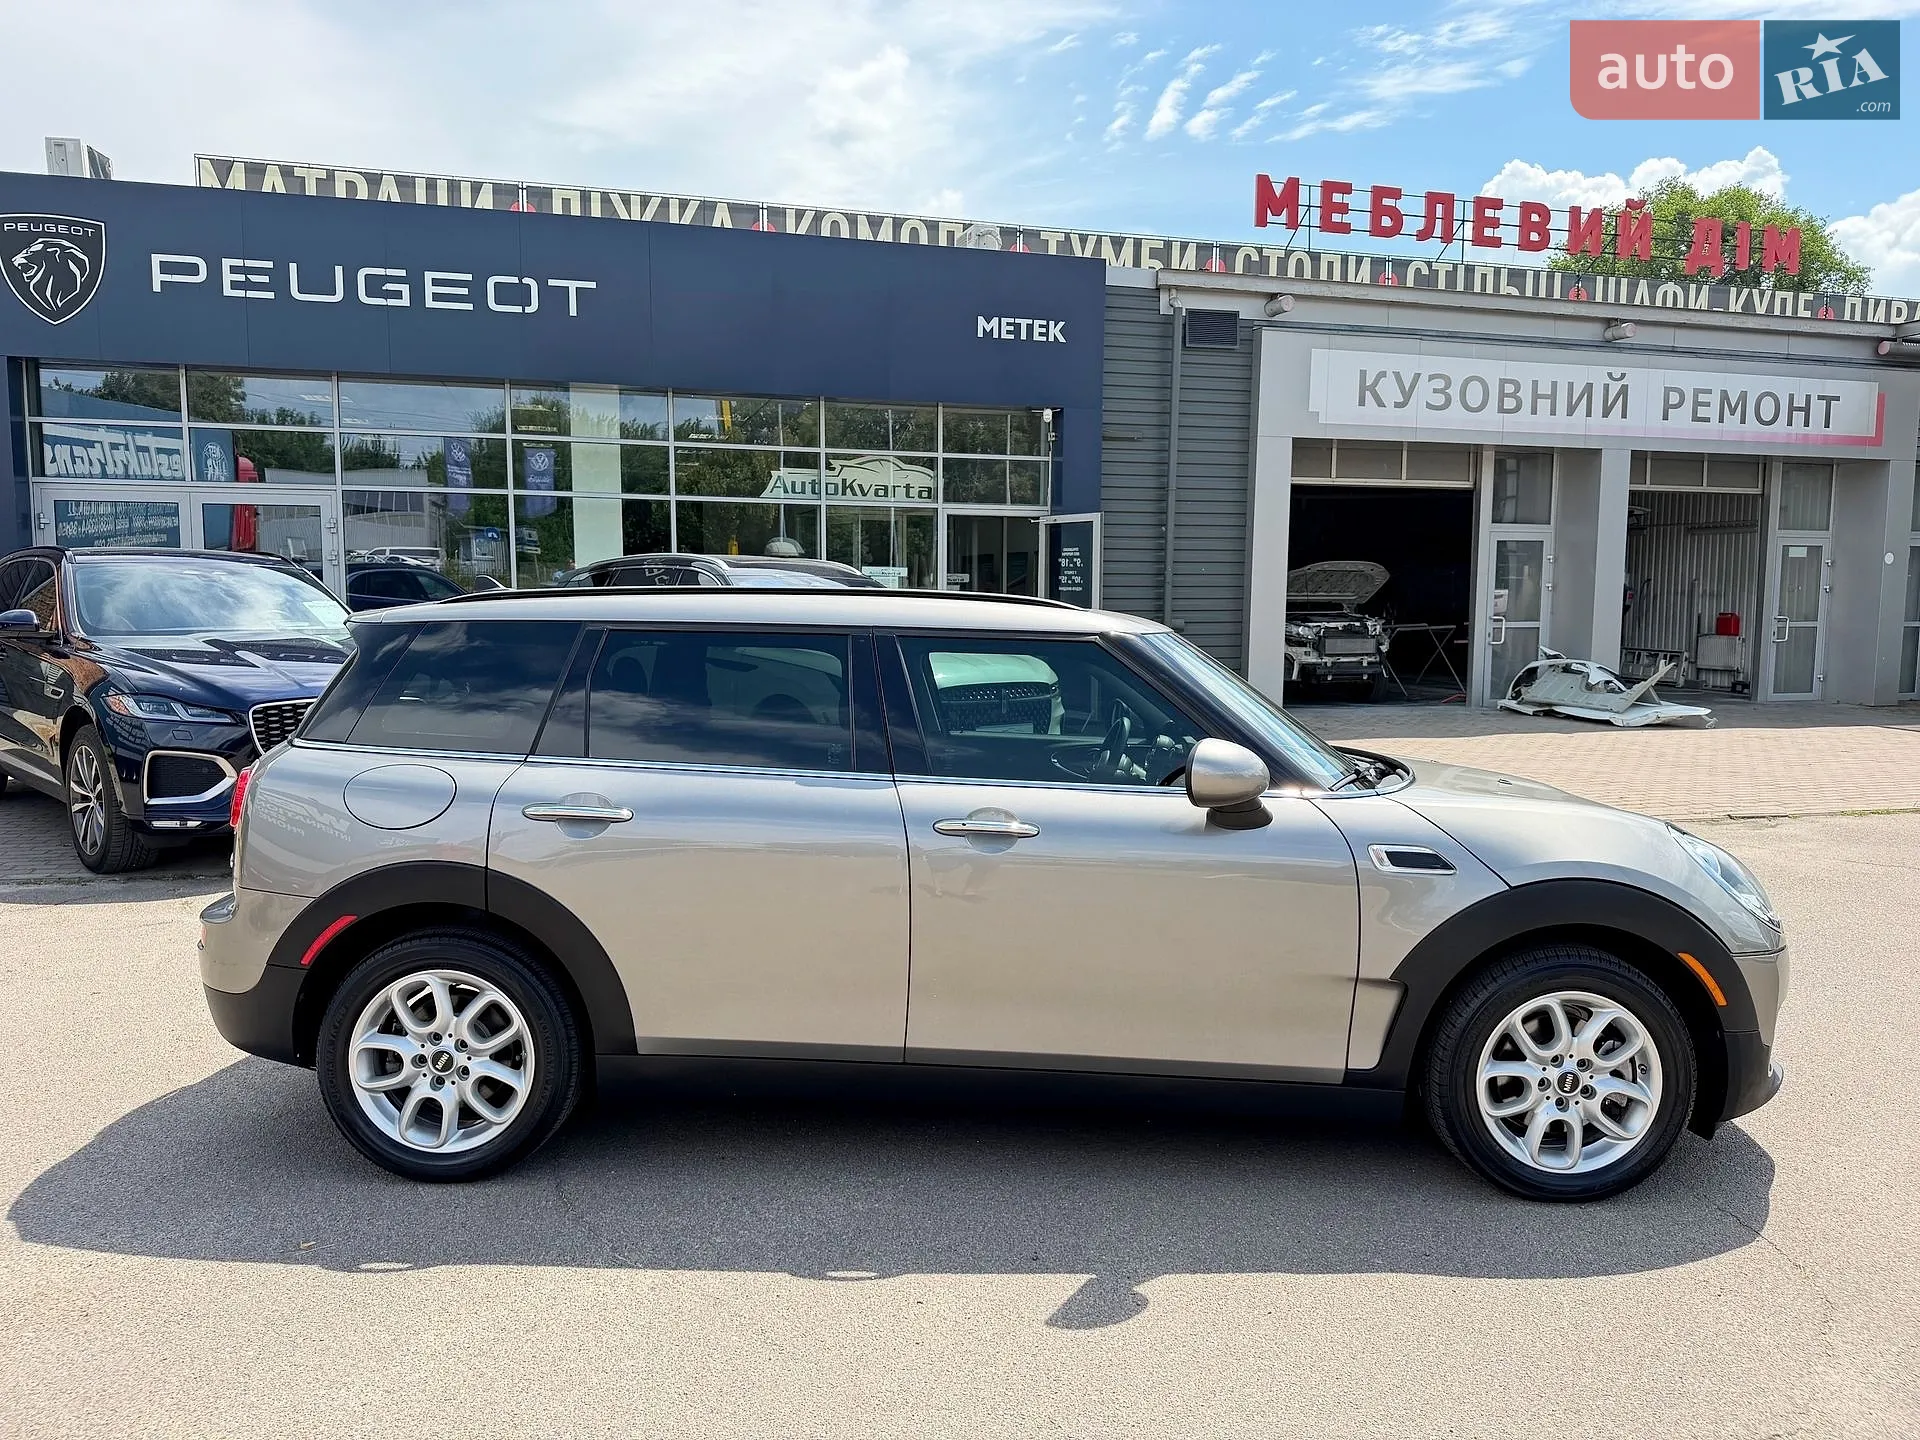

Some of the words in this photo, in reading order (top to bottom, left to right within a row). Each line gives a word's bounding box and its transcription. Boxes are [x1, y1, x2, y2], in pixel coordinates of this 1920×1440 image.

[4, 223, 95, 237] PEUGEOT
[1254, 173, 1653, 261] МЕБЛЕВИЙ
[1684, 216, 1802, 277] ДІМ
[151, 253, 598, 317] PEUGEOT
[977, 315, 1067, 343] METEK
[1357, 368, 1630, 419] КУЗОВНИЙ
[1661, 386, 1841, 429] РЕМОНТ
[769, 474, 934, 500] AutoKvarta
[435, 1053, 450, 1070] MINI
[1563, 1073, 1574, 1092] MINI
